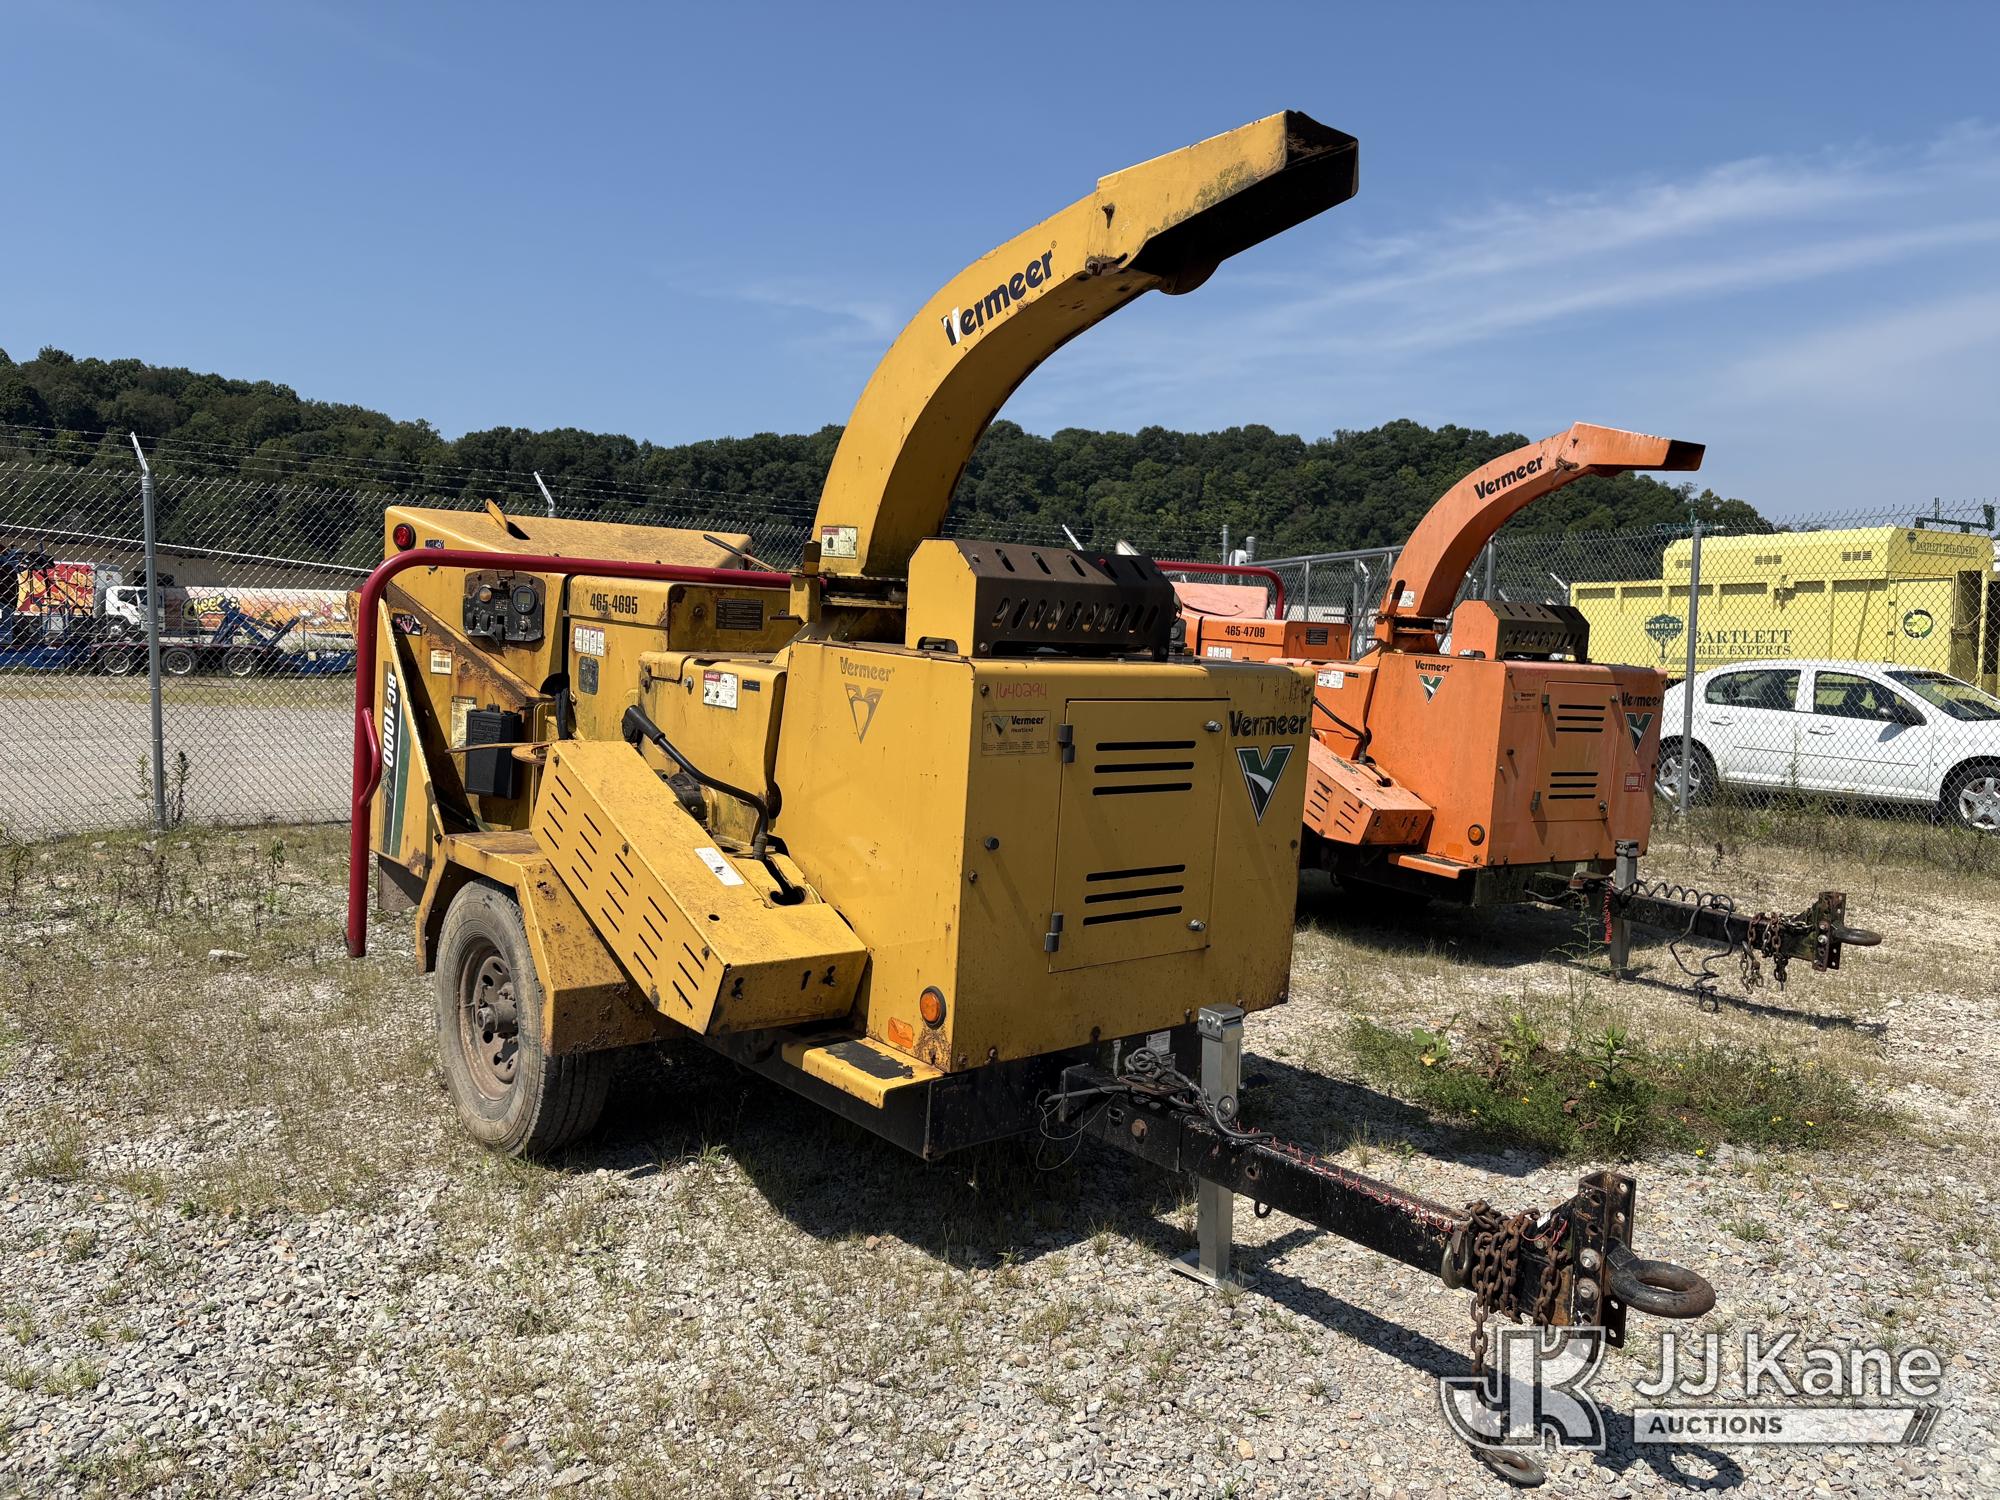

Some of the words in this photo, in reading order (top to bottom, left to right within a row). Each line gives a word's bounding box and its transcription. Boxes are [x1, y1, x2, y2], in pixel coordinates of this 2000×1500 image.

[941, 249, 1053, 346] Vermeer
[1474, 456, 1543, 500] Vermeer
[590, 593, 639, 615] 465-4695
[1225, 625, 1266, 638] 465-4709
[1645, 622, 1684, 630] BARTLETT
[1728, 645, 1791, 655] EXPERTS
[839, 656, 891, 682] Vermeer
[1415, 659, 1450, 672] Vermeer
[1011, 715, 1045, 725] Vermeer
[1228, 711, 1307, 737] Vermeer
